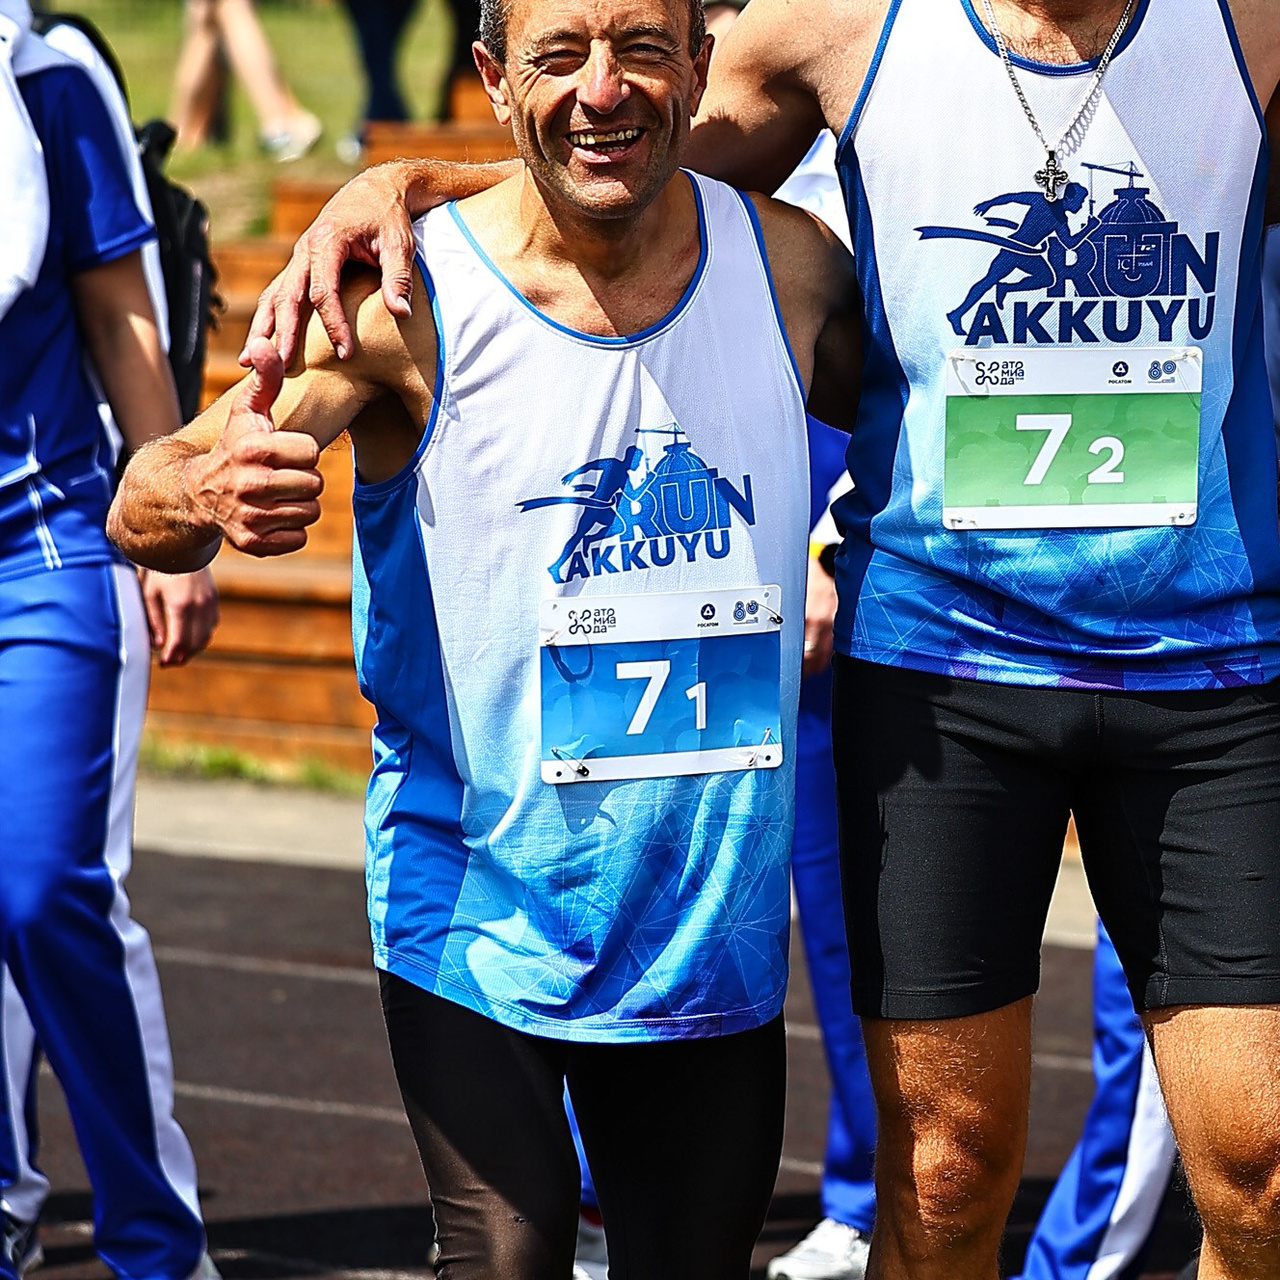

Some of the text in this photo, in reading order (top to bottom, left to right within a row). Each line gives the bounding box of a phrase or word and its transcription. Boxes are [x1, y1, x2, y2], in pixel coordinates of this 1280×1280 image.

[1047, 231, 1220, 298] RUN
[964, 296, 1216, 346] AKKUYU
[1015, 413, 1125, 485] 7 2
[617, 474, 757, 541] RUN
[565, 530, 731, 583] AKKUYU
[616, 659, 707, 735] 7 1
